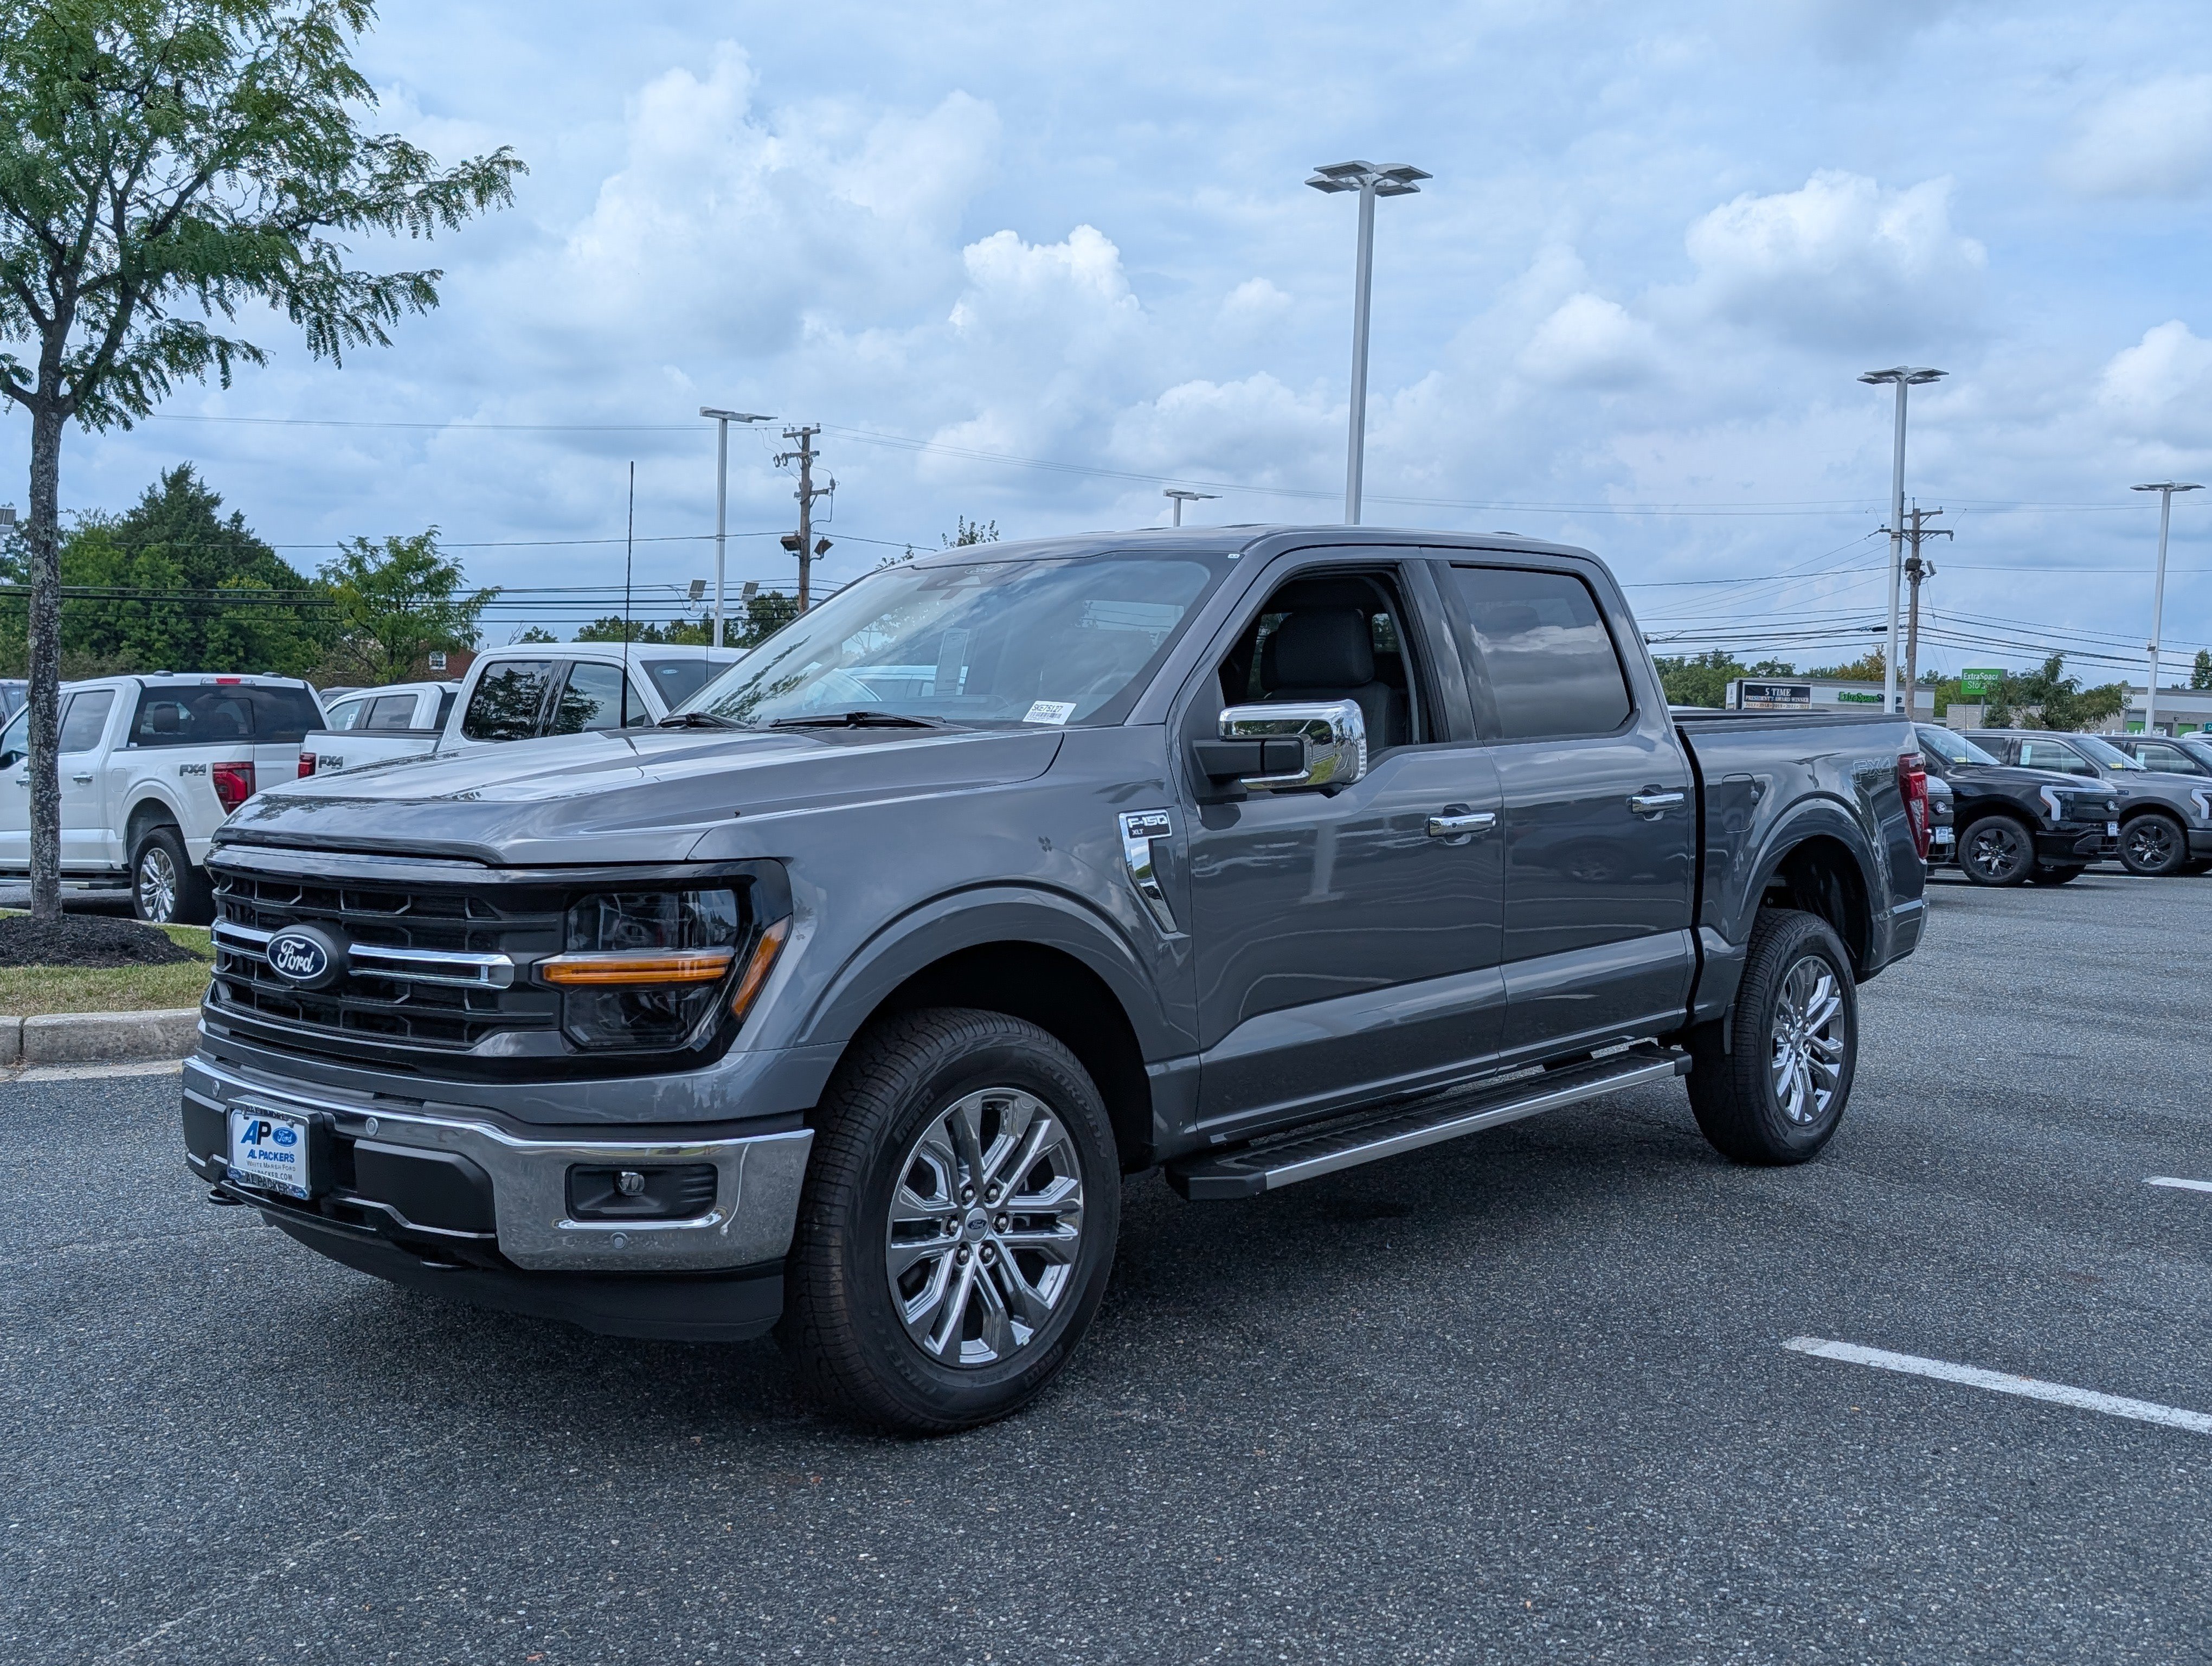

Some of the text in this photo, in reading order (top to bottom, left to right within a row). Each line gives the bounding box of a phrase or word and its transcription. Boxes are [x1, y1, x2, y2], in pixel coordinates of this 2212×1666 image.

[1964, 672, 1999, 681] ExtraSpace
[1771, 688, 1791, 696] TIME
[318, 755, 343, 768] FX4
[179, 764, 206, 776] FX4
[1853, 756, 1893, 786] FX4
[1128, 815, 1168, 828] F-150
[277, 939, 315, 973] Ford
[241, 1120, 271, 1145] AP
[247, 1149, 295, 1163] AL PACKER'S
